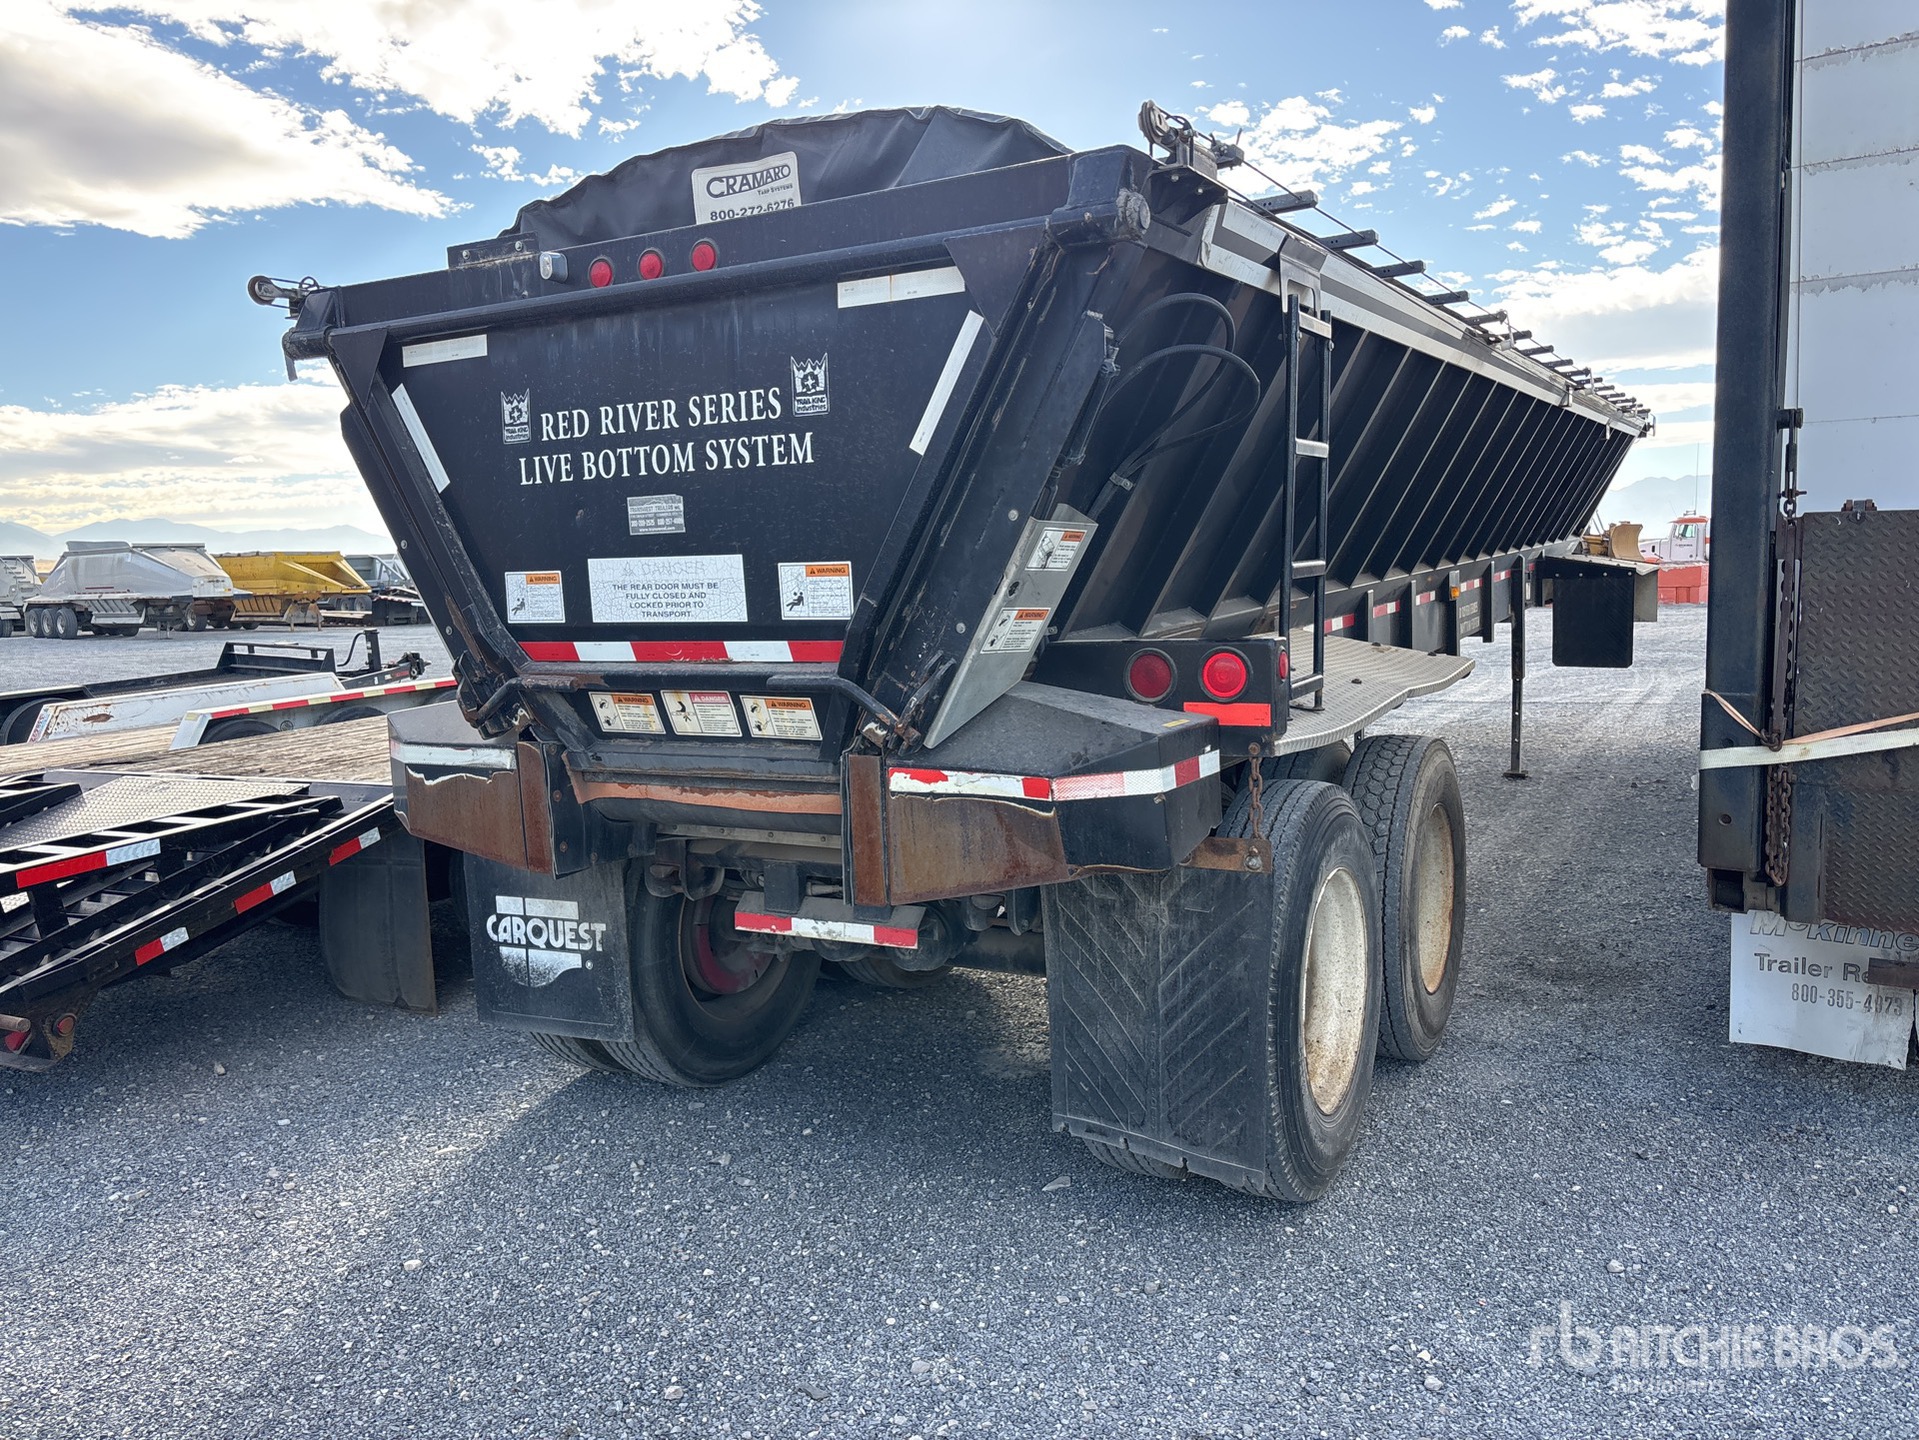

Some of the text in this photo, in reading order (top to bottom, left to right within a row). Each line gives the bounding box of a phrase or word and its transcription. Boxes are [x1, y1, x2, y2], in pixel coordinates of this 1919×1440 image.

[706, 164, 791, 198] CRAMARO
[710, 199, 794, 221] 800-272-6276
[540, 387, 782, 441] RED RIVER SERIES
[519, 432, 815, 485] LIVE BOTTOM SYSTEM
[682, 582, 704, 590] MUST
[665, 601, 691, 609] PRIOR
[486, 914, 607, 952] CARQUEST
[1754, 953, 1833, 979] Trailer
